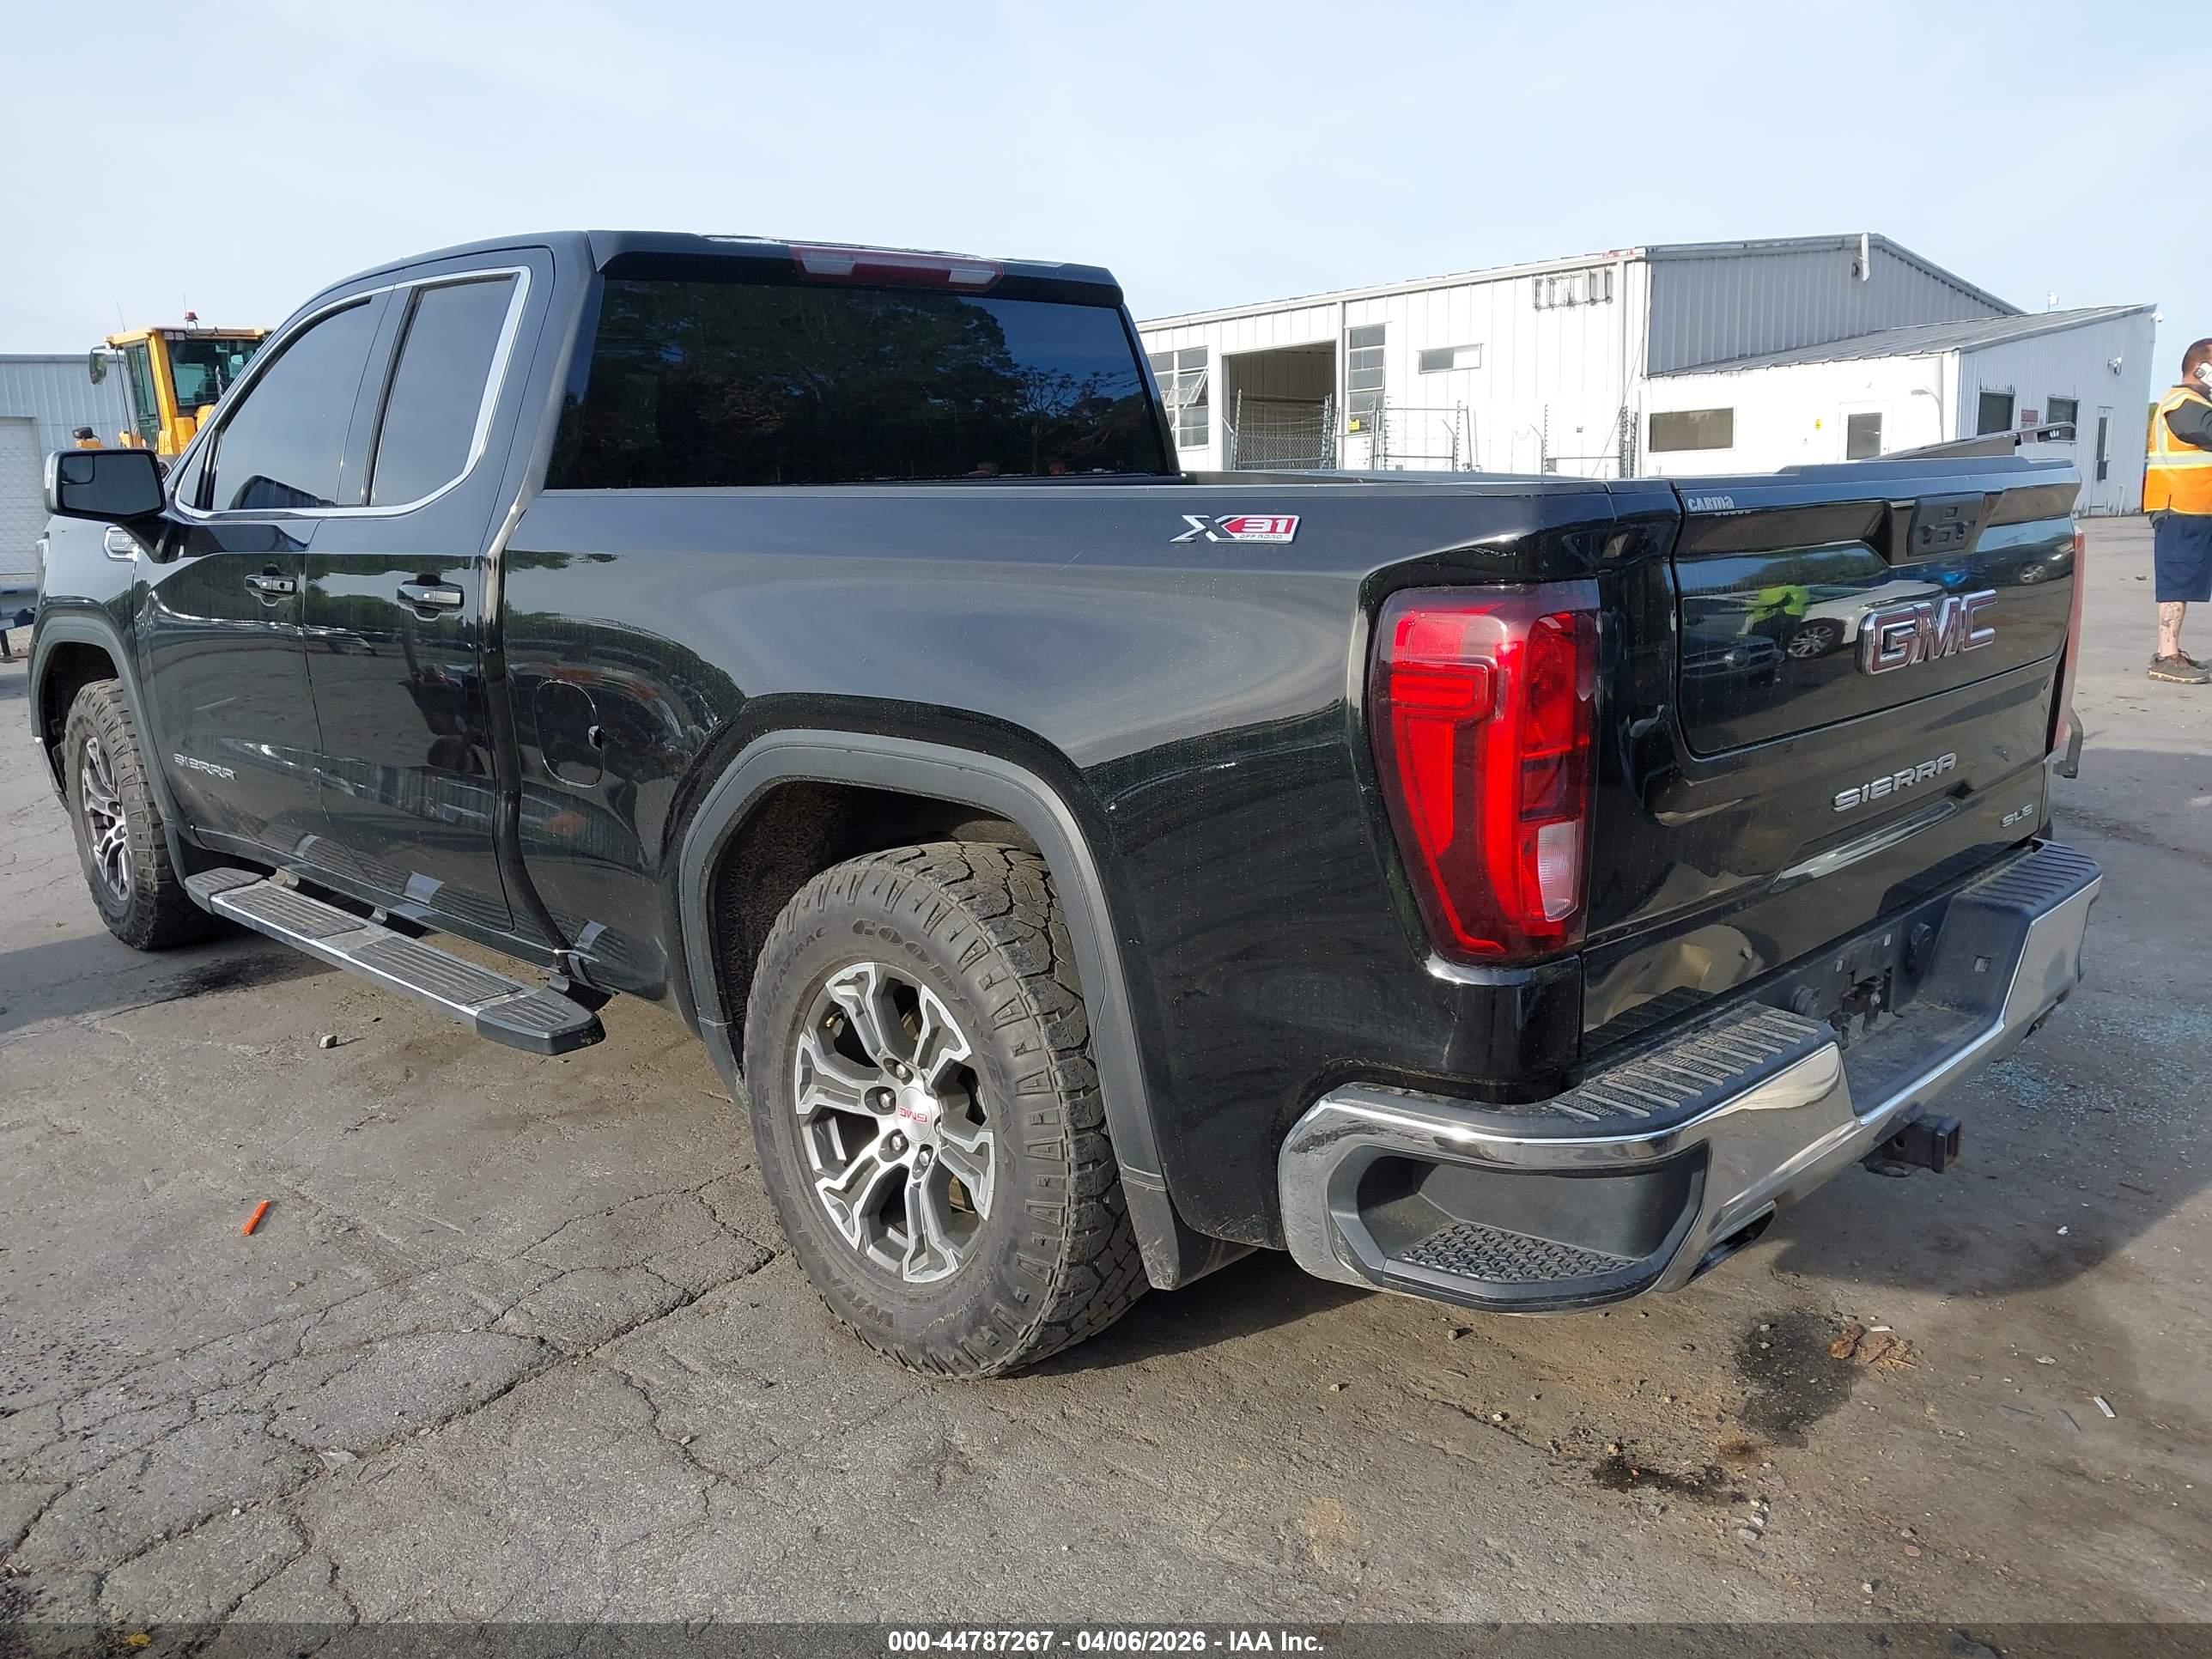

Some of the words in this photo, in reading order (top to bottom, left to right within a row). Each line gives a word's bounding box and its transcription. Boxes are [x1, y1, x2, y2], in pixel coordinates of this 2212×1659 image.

[1856, 589, 1998, 676] GMC
[173, 753, 237, 782] SIERRA
[1832, 752, 1957, 812] SIERRA
[2000, 804, 2033, 828] SLE
[897, 1106, 929, 1123] GMC
